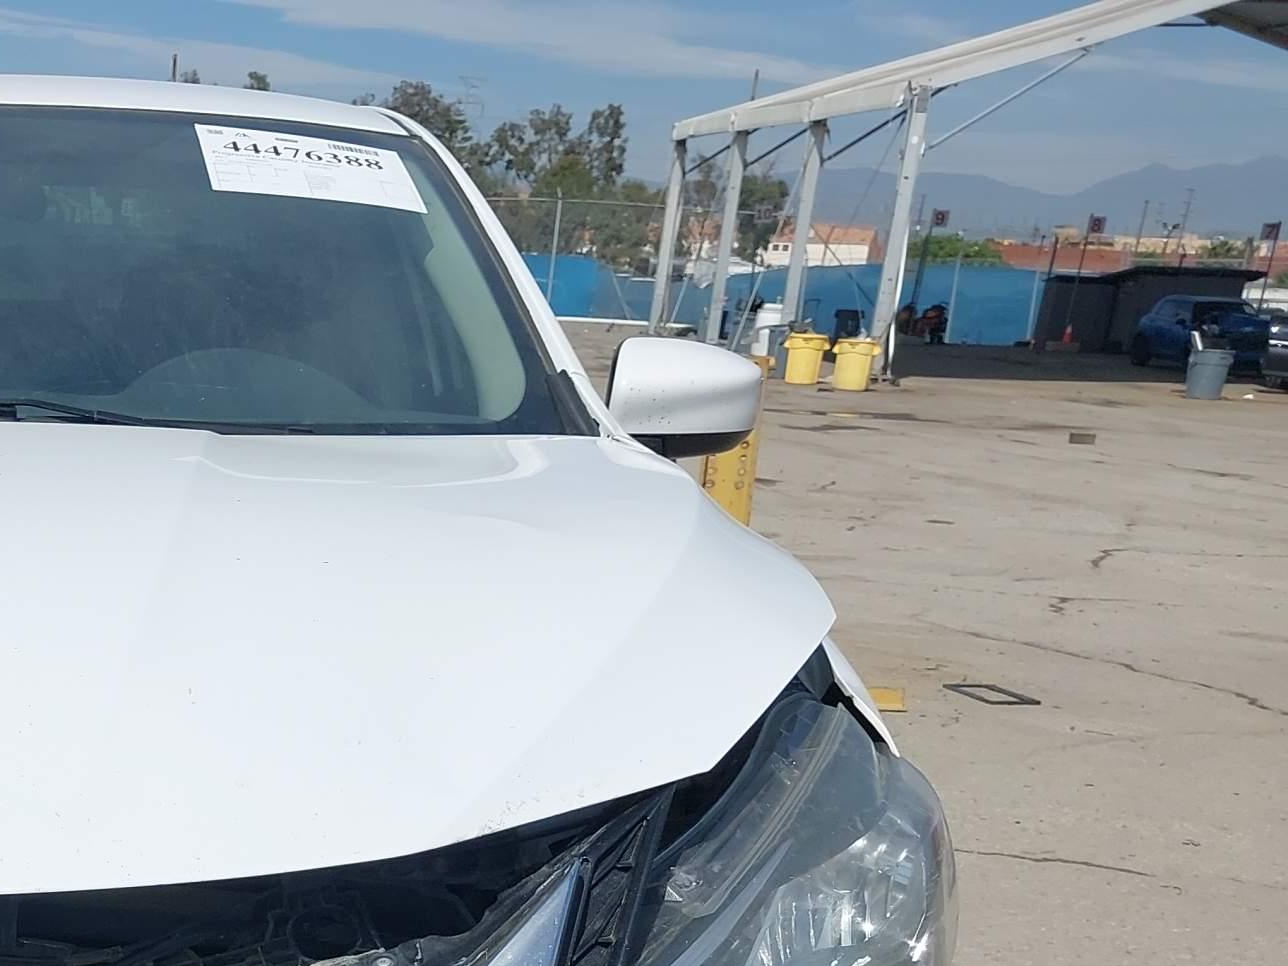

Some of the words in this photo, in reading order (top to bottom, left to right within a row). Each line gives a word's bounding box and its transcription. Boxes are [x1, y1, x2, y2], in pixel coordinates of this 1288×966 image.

[223, 140, 384, 170] 44476388
[935, 211, 945, 225] 9
[1091, 217, 1102, 233] 8
